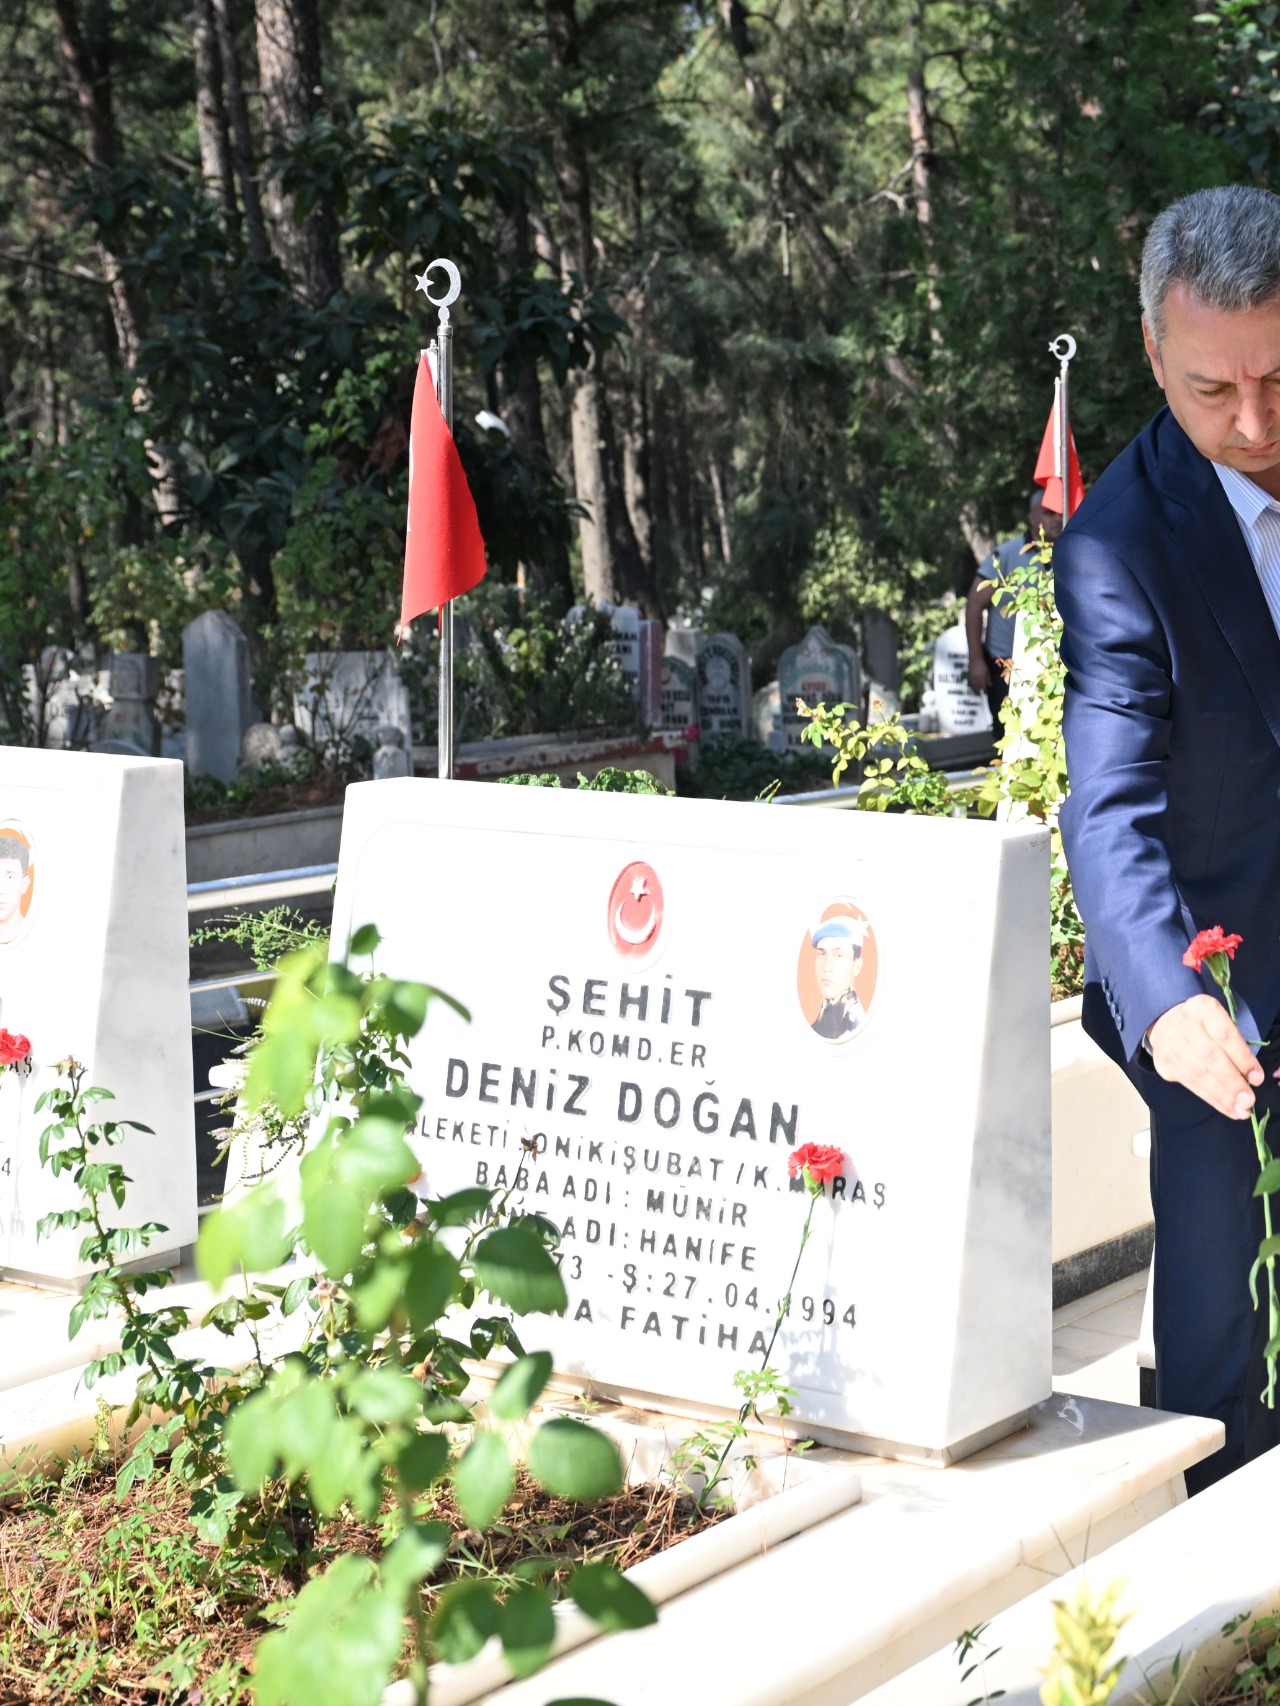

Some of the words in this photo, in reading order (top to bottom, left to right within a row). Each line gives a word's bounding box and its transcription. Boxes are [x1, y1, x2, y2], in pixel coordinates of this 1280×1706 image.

[546, 974, 713, 1028] ŞEHİT
[541, 1025, 708, 1068] P.KOMD.ER
[445, 1058, 591, 1117] DENİZ
[617, 1079, 800, 1146] DOĞAN
[476, 1160, 550, 1195] BABA
[620, 1305, 768, 1357] FATİHA
